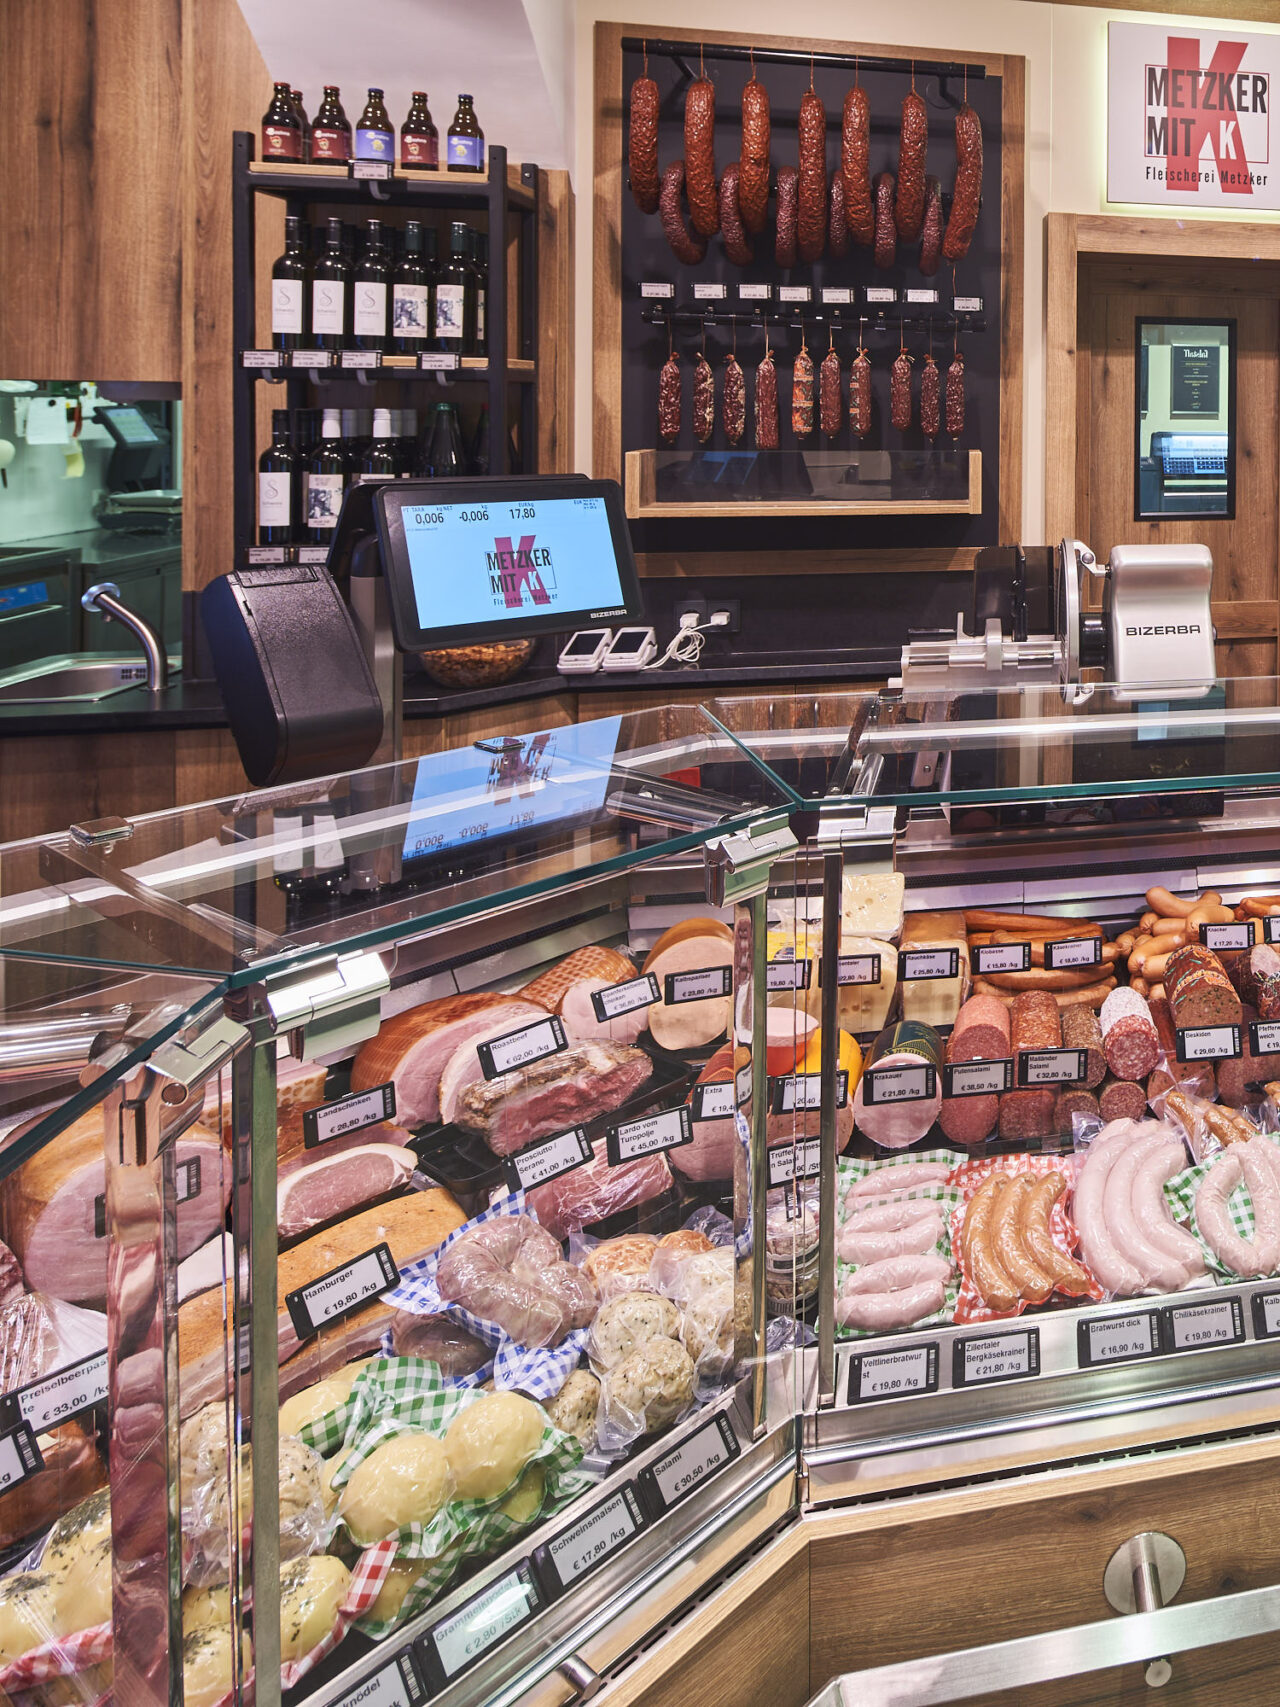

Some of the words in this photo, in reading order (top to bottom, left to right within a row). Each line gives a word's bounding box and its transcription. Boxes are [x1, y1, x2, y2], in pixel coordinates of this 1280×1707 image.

[1147, 67, 1267, 113] METZKER
[1147, 116, 1195, 157] MIT
[1146, 166, 1215, 183] Fleischerei
[1220, 174, 1268, 186] Metzker
[415, 513, 444, 525] 0,006
[459, 510, 489, 523] -0,006
[509, 508, 536, 520] 17,80
[487, 548, 551, 571] METZKER
[490, 573, 516, 594] MIT
[1125, 624, 1201, 637] BIZERBA
[491, 1033, 528, 1051] Roastbeef
[536, 1044, 550, 1052] /kg
[874, 1073, 902, 1081] Krakauer
[1061, 1071, 1072, 1079] /kg
[887, 1089, 906, 1098] 21,80
[909, 1088, 920, 1096] /kg
[987, 1082, 998, 1090] /kg
[318, 1095, 371, 1118] Landschinken
[337, 1119, 360, 1132] 28,80
[363, 1113, 377, 1122] /kg
[619, 1125, 641, 1136] Lardo
[642, 1119, 658, 1129] vom
[620, 1129, 655, 1144] Turopolje
[638, 1139, 658, 1151] 45,00
[662, 1134, 675, 1144] /kg
[517, 1143, 553, 1165] Prosciutto
[519, 1158, 545, 1174] Serano
[538, 1162, 560, 1178] 41,00
[563, 1155, 576, 1168] /kg
[304, 1268, 354, 1301] Hamburger
[324, 1305, 331, 1316] €
[332, 1292, 358, 1312] 19,80
[361, 1281, 377, 1296] /kg
[1090, 1320, 1124, 1333] Bratwurst
[1126, 1318, 1142, 1328] dick
[1276, 1319, 1280, 1328] €
[1185, 1333, 1190, 1342] €
[1192, 1330, 1212, 1341] 19,80
[1214, 1328, 1227, 1338] /kg
[965, 1339, 1000, 1352] Zillertaler
[1102, 1347, 1107, 1356] €
[1108, 1344, 1129, 1355] 16,90
[1131, 1341, 1145, 1352] /kg
[863, 1352, 922, 1368] Veltlinerbratwur
[966, 1347, 1026, 1363] Bergkäsekrainer
[862, 1371, 870, 1379] st
[977, 1366, 982, 1375] €
[983, 1364, 1004, 1375] 21,80
[1007, 1361, 1021, 1372] /kg
[872, 1383, 878, 1392] €
[879, 1380, 901, 1391] 19,80
[904, 1377, 918, 1389] /kg
[22, 1405, 35, 1415] te
[43, 1410, 51, 1421] €
[53, 1393, 87, 1417] 33,00
[655, 1453, 683, 1476] Salami
[675, 1483, 681, 1492] €
[680, 1466, 704, 1488] 30,50
[706, 1454, 721, 1469] /kg
[551, 1497, 623, 1555] Schweinsmaisen
[574, 1560, 581, 1571] €
[581, 1541, 607, 1565] 17,80
[610, 1527, 626, 1543] /kg
[466, 1645, 472, 1655] €
[474, 1625, 497, 1649] 2,80
[500, 1606, 523, 1629] /Stk
